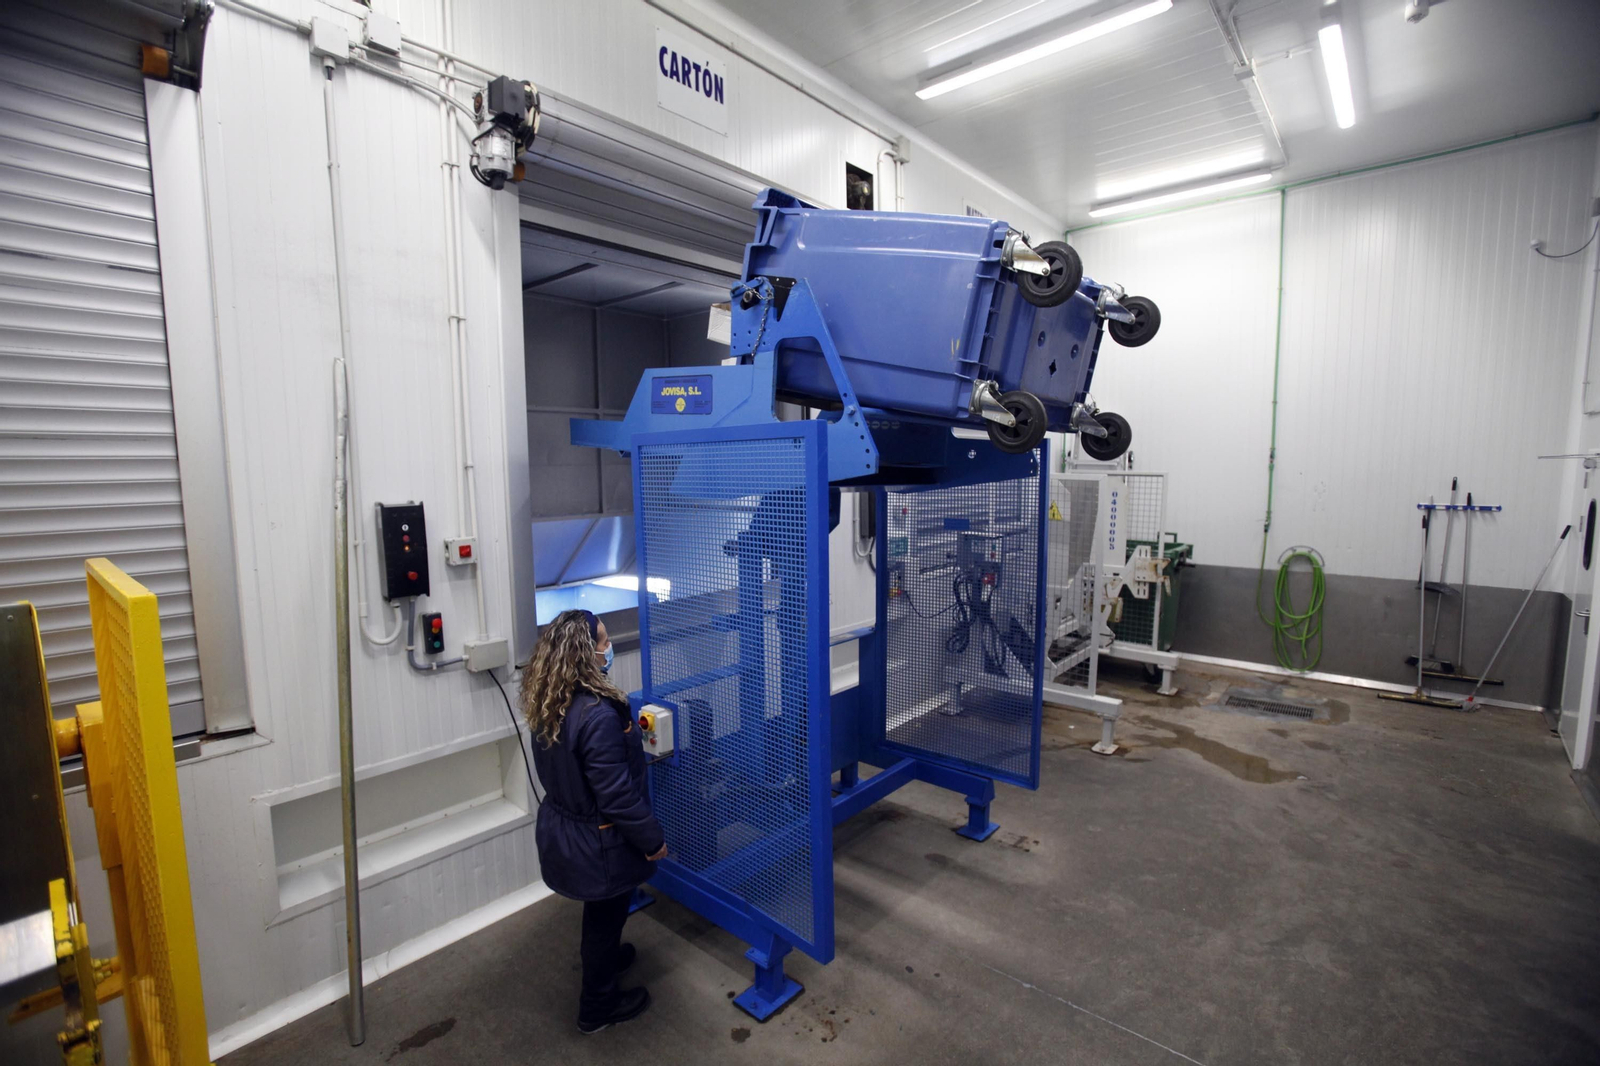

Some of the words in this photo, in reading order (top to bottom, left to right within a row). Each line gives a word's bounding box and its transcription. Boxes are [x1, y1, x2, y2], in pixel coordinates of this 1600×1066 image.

[659, 45, 724, 105] CARTÓN
[661, 386, 687, 397] JOVISA,
[688, 386, 702, 395] S.L.
[1109, 491, 1118, 551] 04000005
